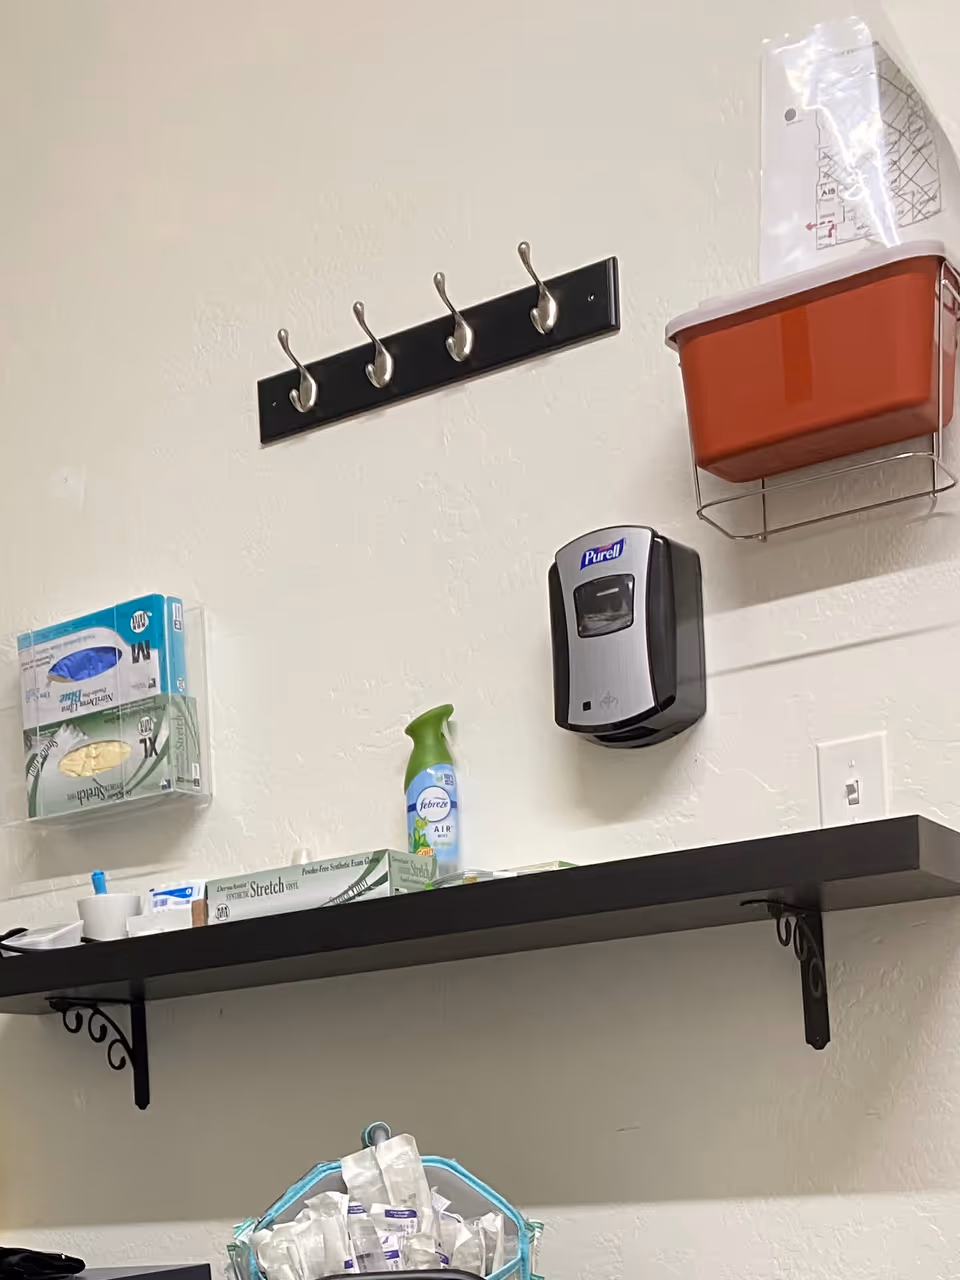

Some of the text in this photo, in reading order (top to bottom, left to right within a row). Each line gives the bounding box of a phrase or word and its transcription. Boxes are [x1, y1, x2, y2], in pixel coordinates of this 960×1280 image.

[585, 543, 620, 565] Purell
[131, 640, 151, 664] M
[59, 688, 82, 703] Blue
[139, 735, 159, 758] XL
[76, 785, 105, 806] Stretch
[420, 798, 448, 811] febreze
[433, 825, 451, 833] AIR
[301, 863, 330, 876] Powder-Free
[329, 860, 350, 871] Synthetic
[250, 876, 284, 898] Stretch
